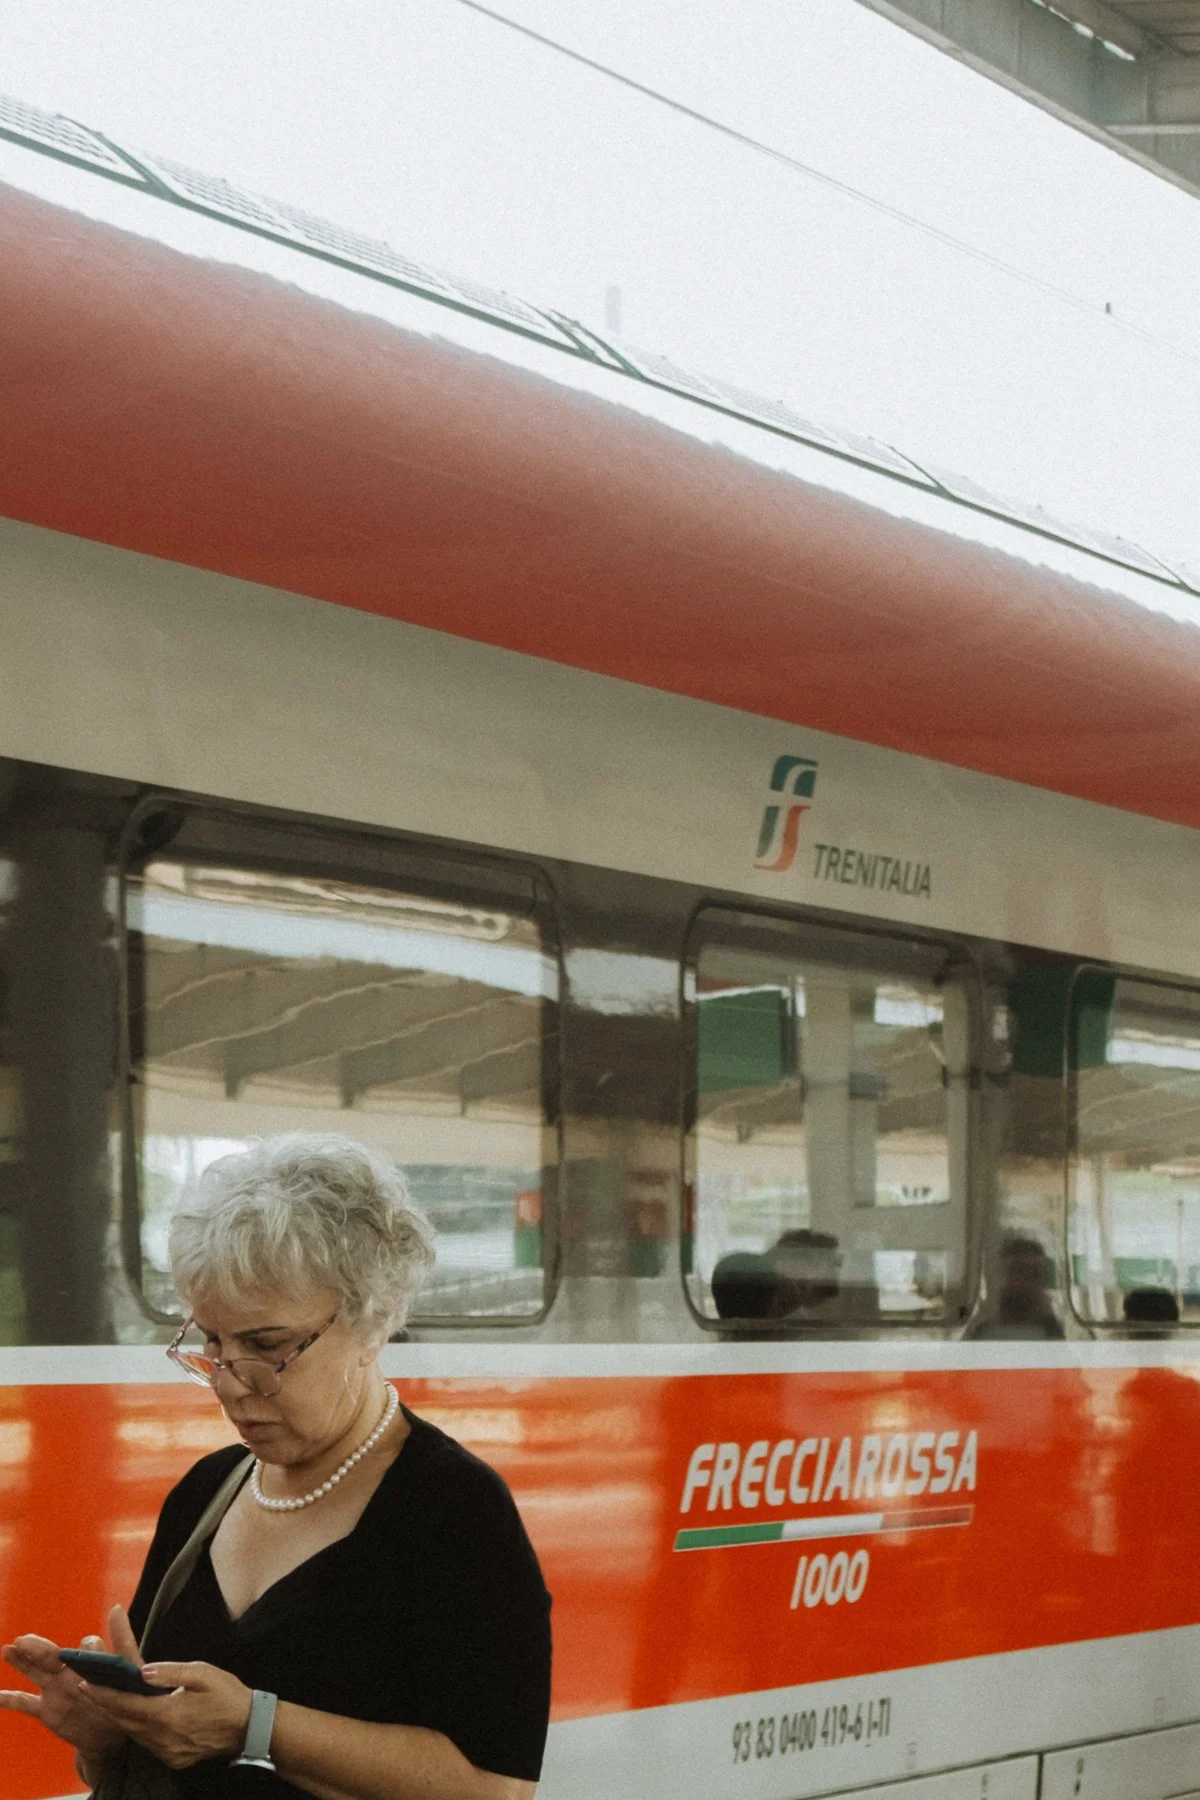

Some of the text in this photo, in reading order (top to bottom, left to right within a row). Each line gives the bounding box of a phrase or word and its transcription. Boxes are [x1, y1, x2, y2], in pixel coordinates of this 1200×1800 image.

[814, 843, 932, 899] TRENITALIA
[680, 1430, 978, 1514] FRECCIAROSSA
[789, 1549, 869, 1610] 1000
[732, 1720, 751, 1764] 93
[756, 1716, 776, 1759] 83
[780, 1708, 817, 1755] 0400
[821, 1702, 863, 1747] 419-6
